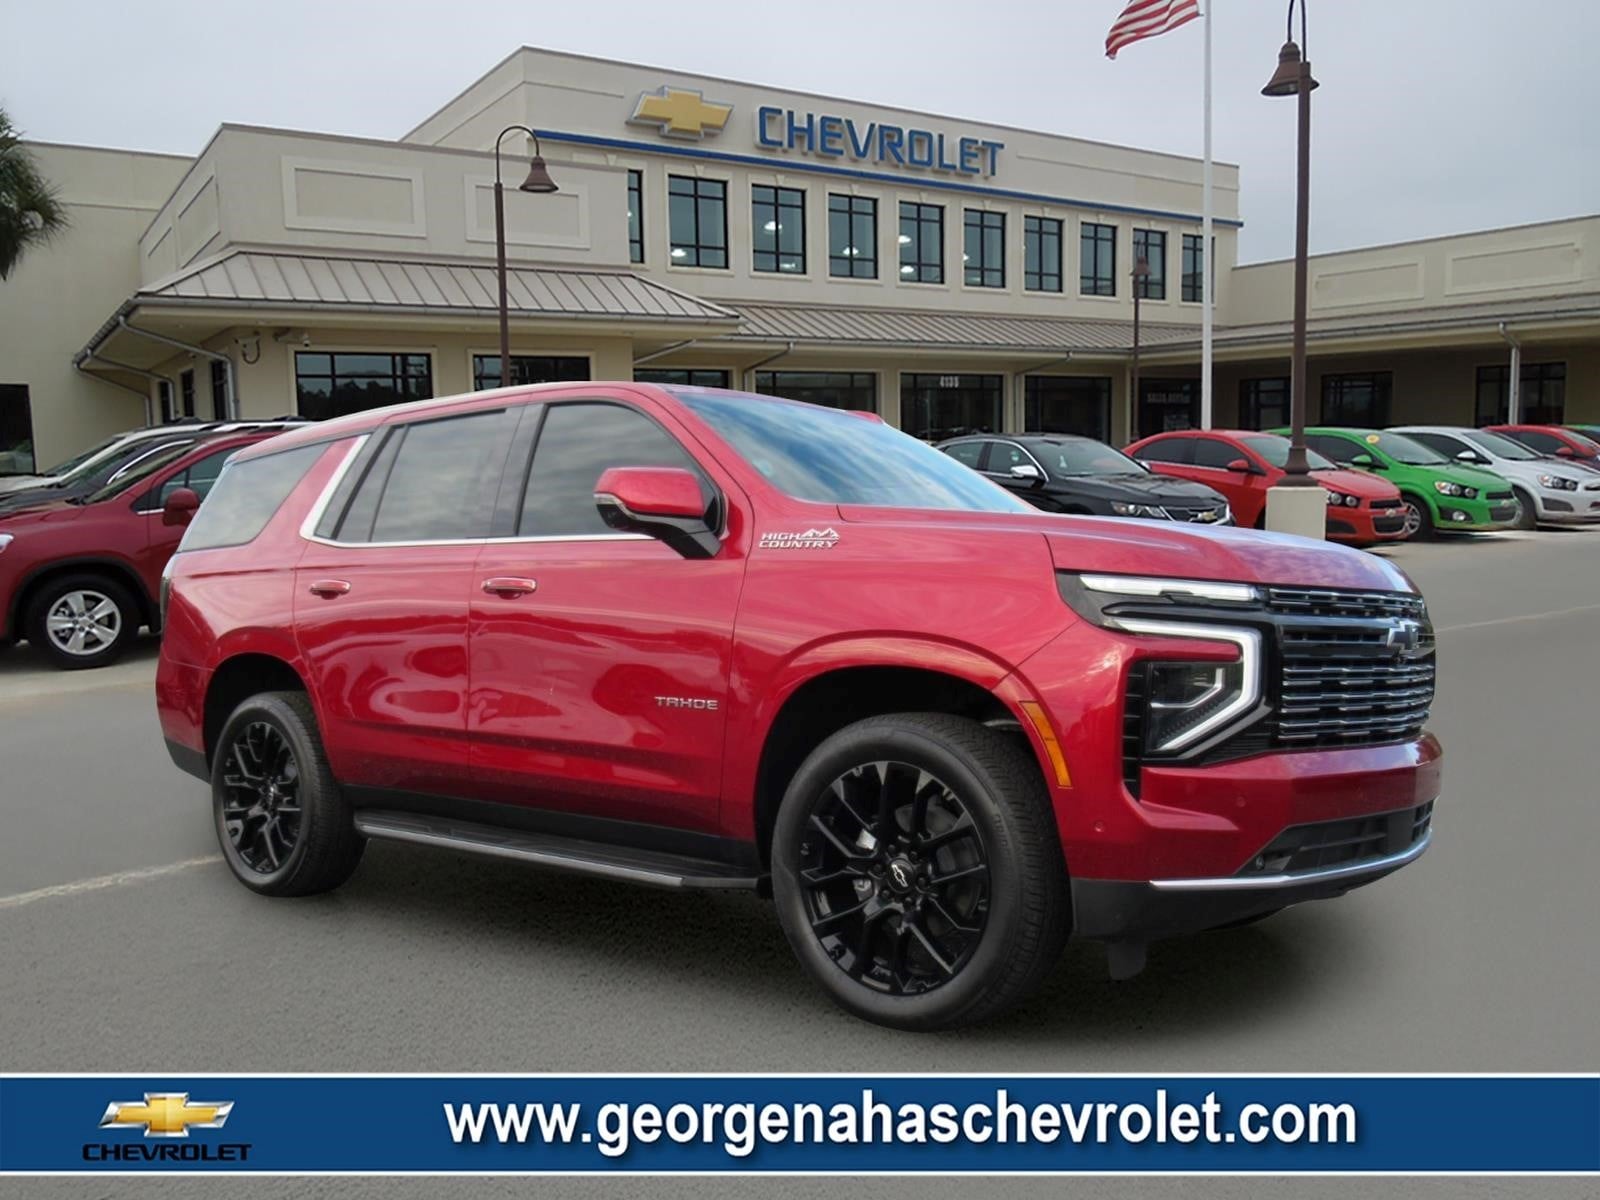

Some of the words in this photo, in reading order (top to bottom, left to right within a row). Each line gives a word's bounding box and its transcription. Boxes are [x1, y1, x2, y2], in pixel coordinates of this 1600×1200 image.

[758, 106, 1005, 177] CHEVROLET
[761, 532, 800, 540] HIGH
[759, 540, 838, 549] COUNTRY
[654, 696, 719, 710] TAHOE
